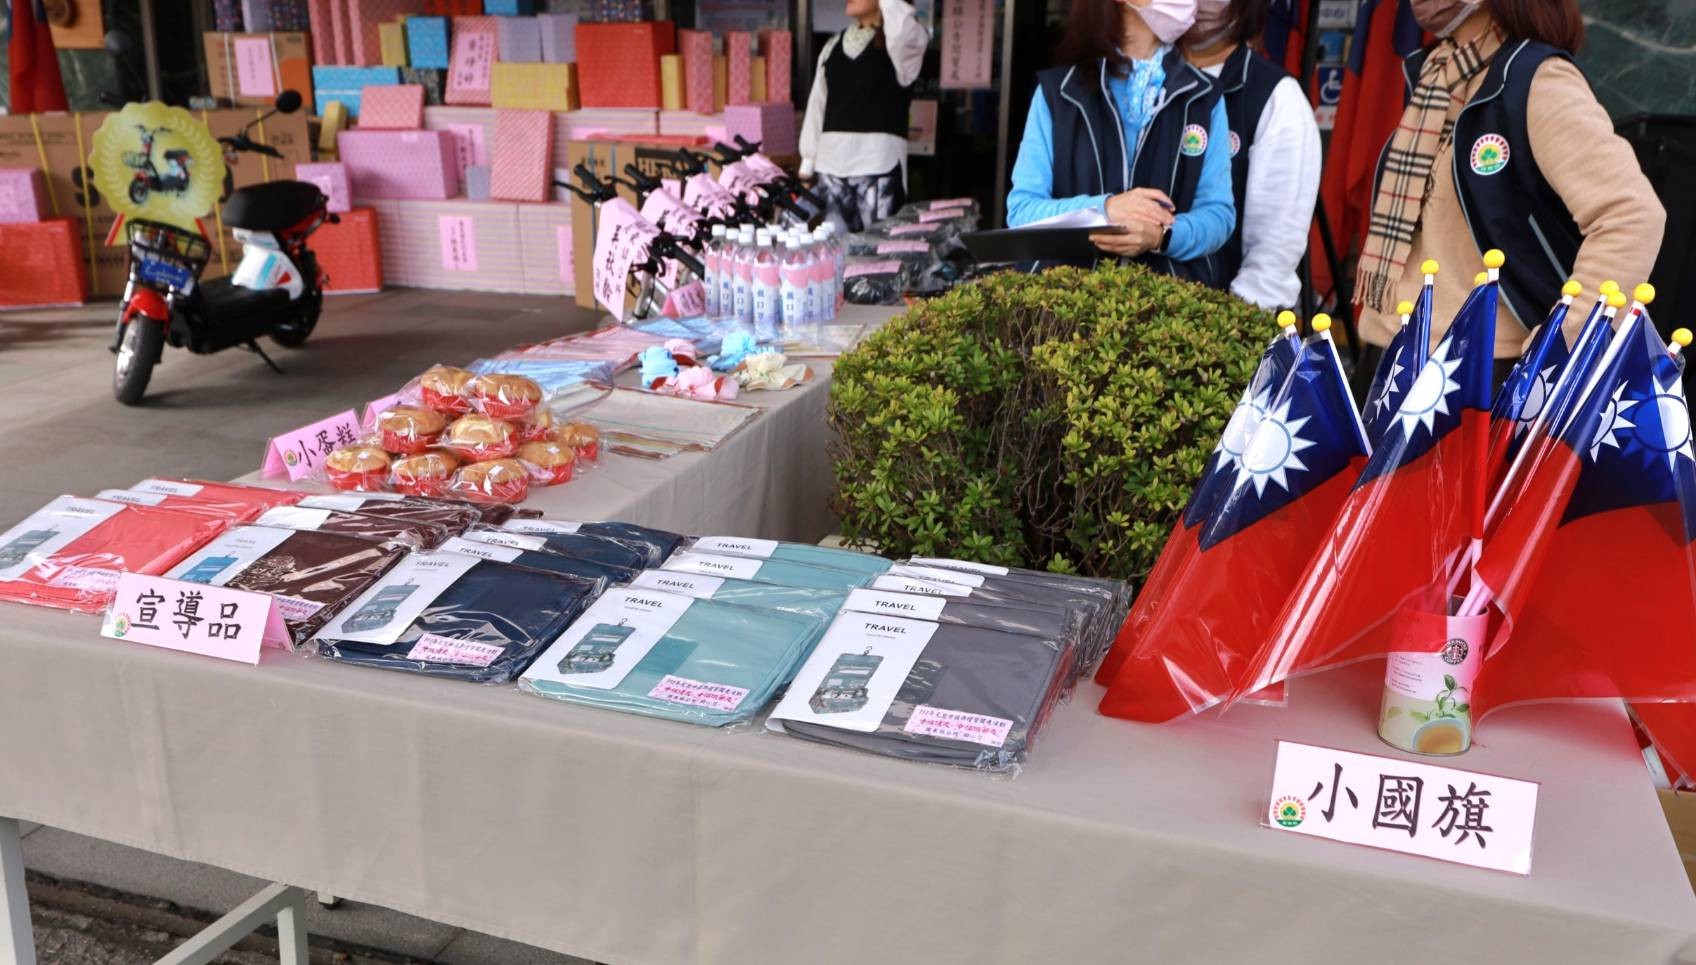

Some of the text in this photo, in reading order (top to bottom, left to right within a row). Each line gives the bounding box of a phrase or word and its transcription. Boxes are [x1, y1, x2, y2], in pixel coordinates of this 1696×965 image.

[298, 422, 357, 468] 小蛋糕
[717, 542, 753, 551] TRAVEL
[459, 547, 494, 558] TRAVEL
[699, 560, 736, 571] TRAVEL
[656, 579, 696, 590] TRAVEL
[904, 584, 943, 595] TRAVEL
[624, 596, 664, 608] TRAVEL
[875, 600, 918, 611] TRAVEL
[130, 588, 242, 641] 宣導品
[864, 622, 908, 634] TRAVEL
[1307, 762, 1494, 849] 小國旗
